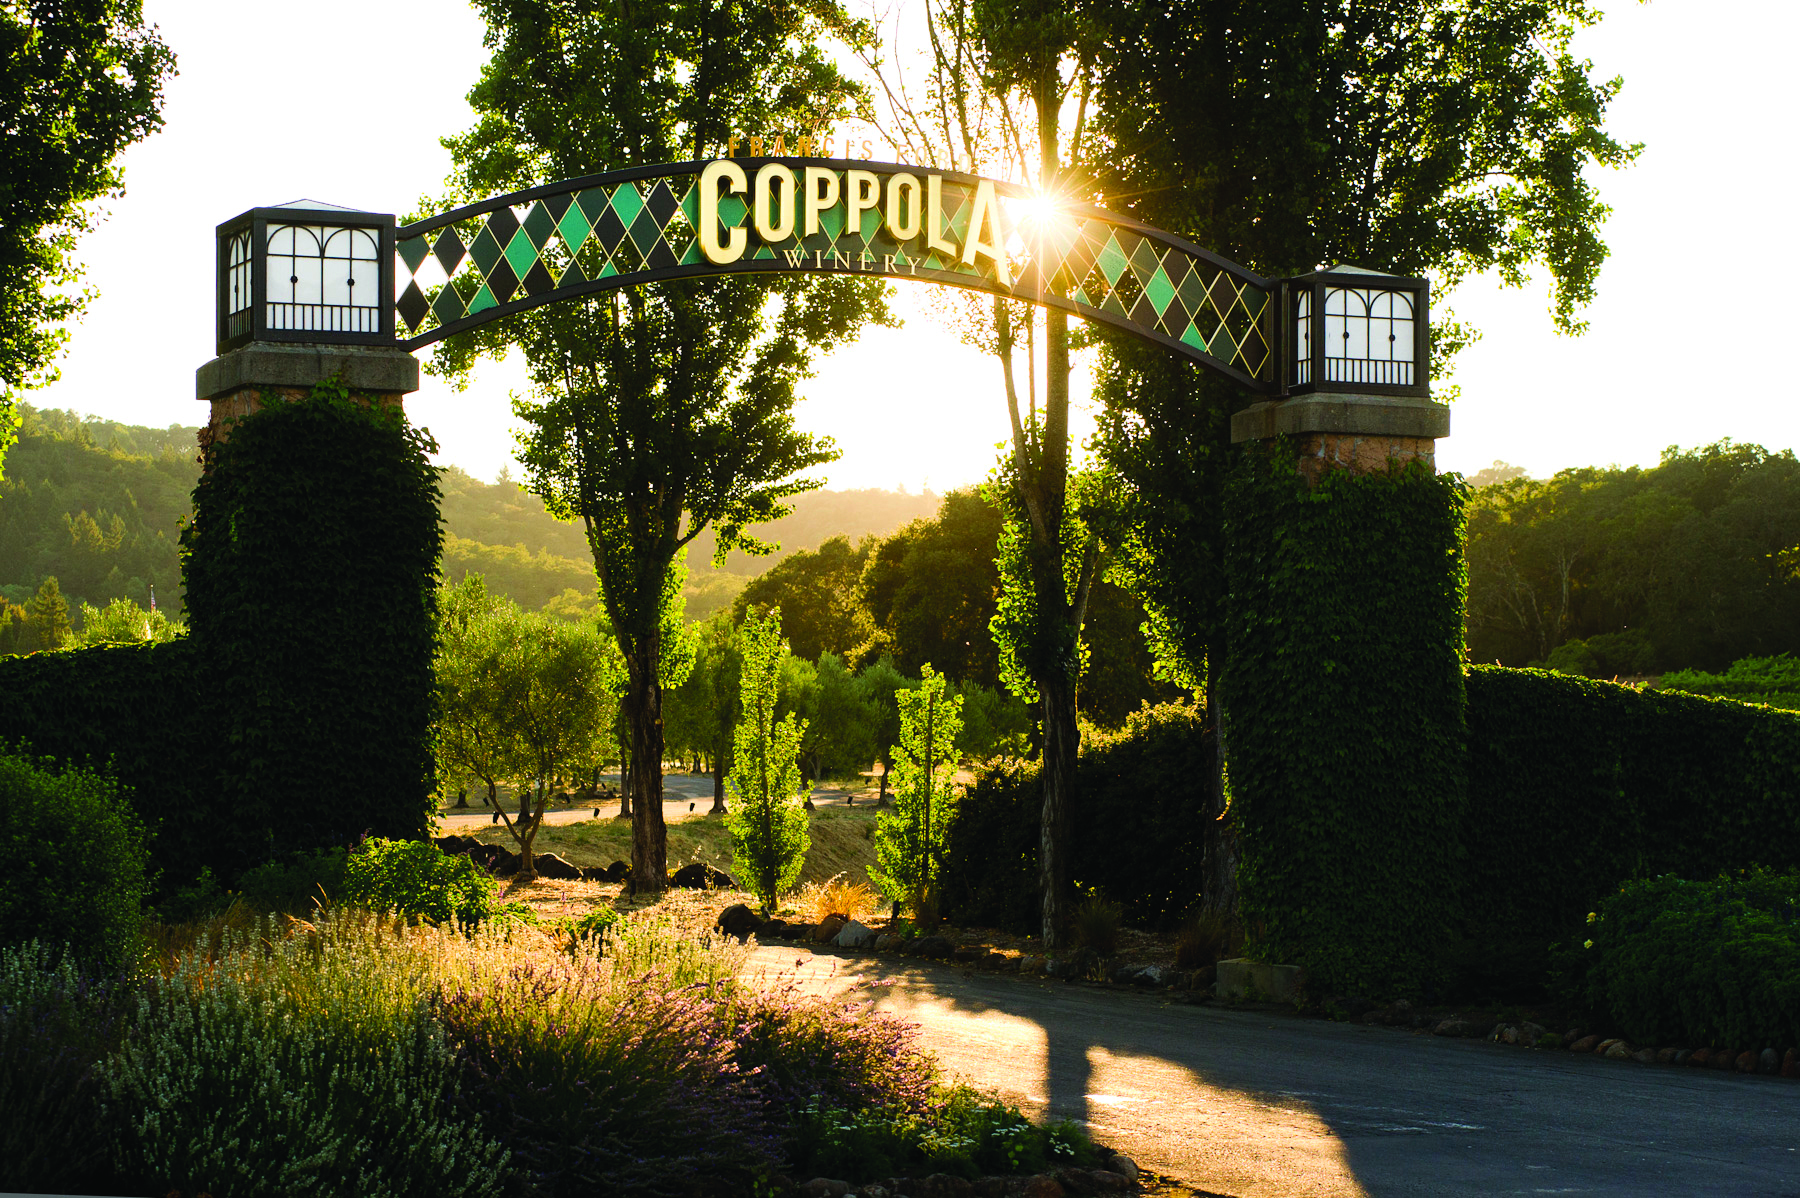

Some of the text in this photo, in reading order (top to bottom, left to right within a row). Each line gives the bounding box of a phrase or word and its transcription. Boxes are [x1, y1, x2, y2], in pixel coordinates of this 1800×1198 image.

[728, 136, 973, 173] FRANCIS FORD
[700, 159, 1012, 290] COPPOLA
[783, 249, 923, 276] WINERY
